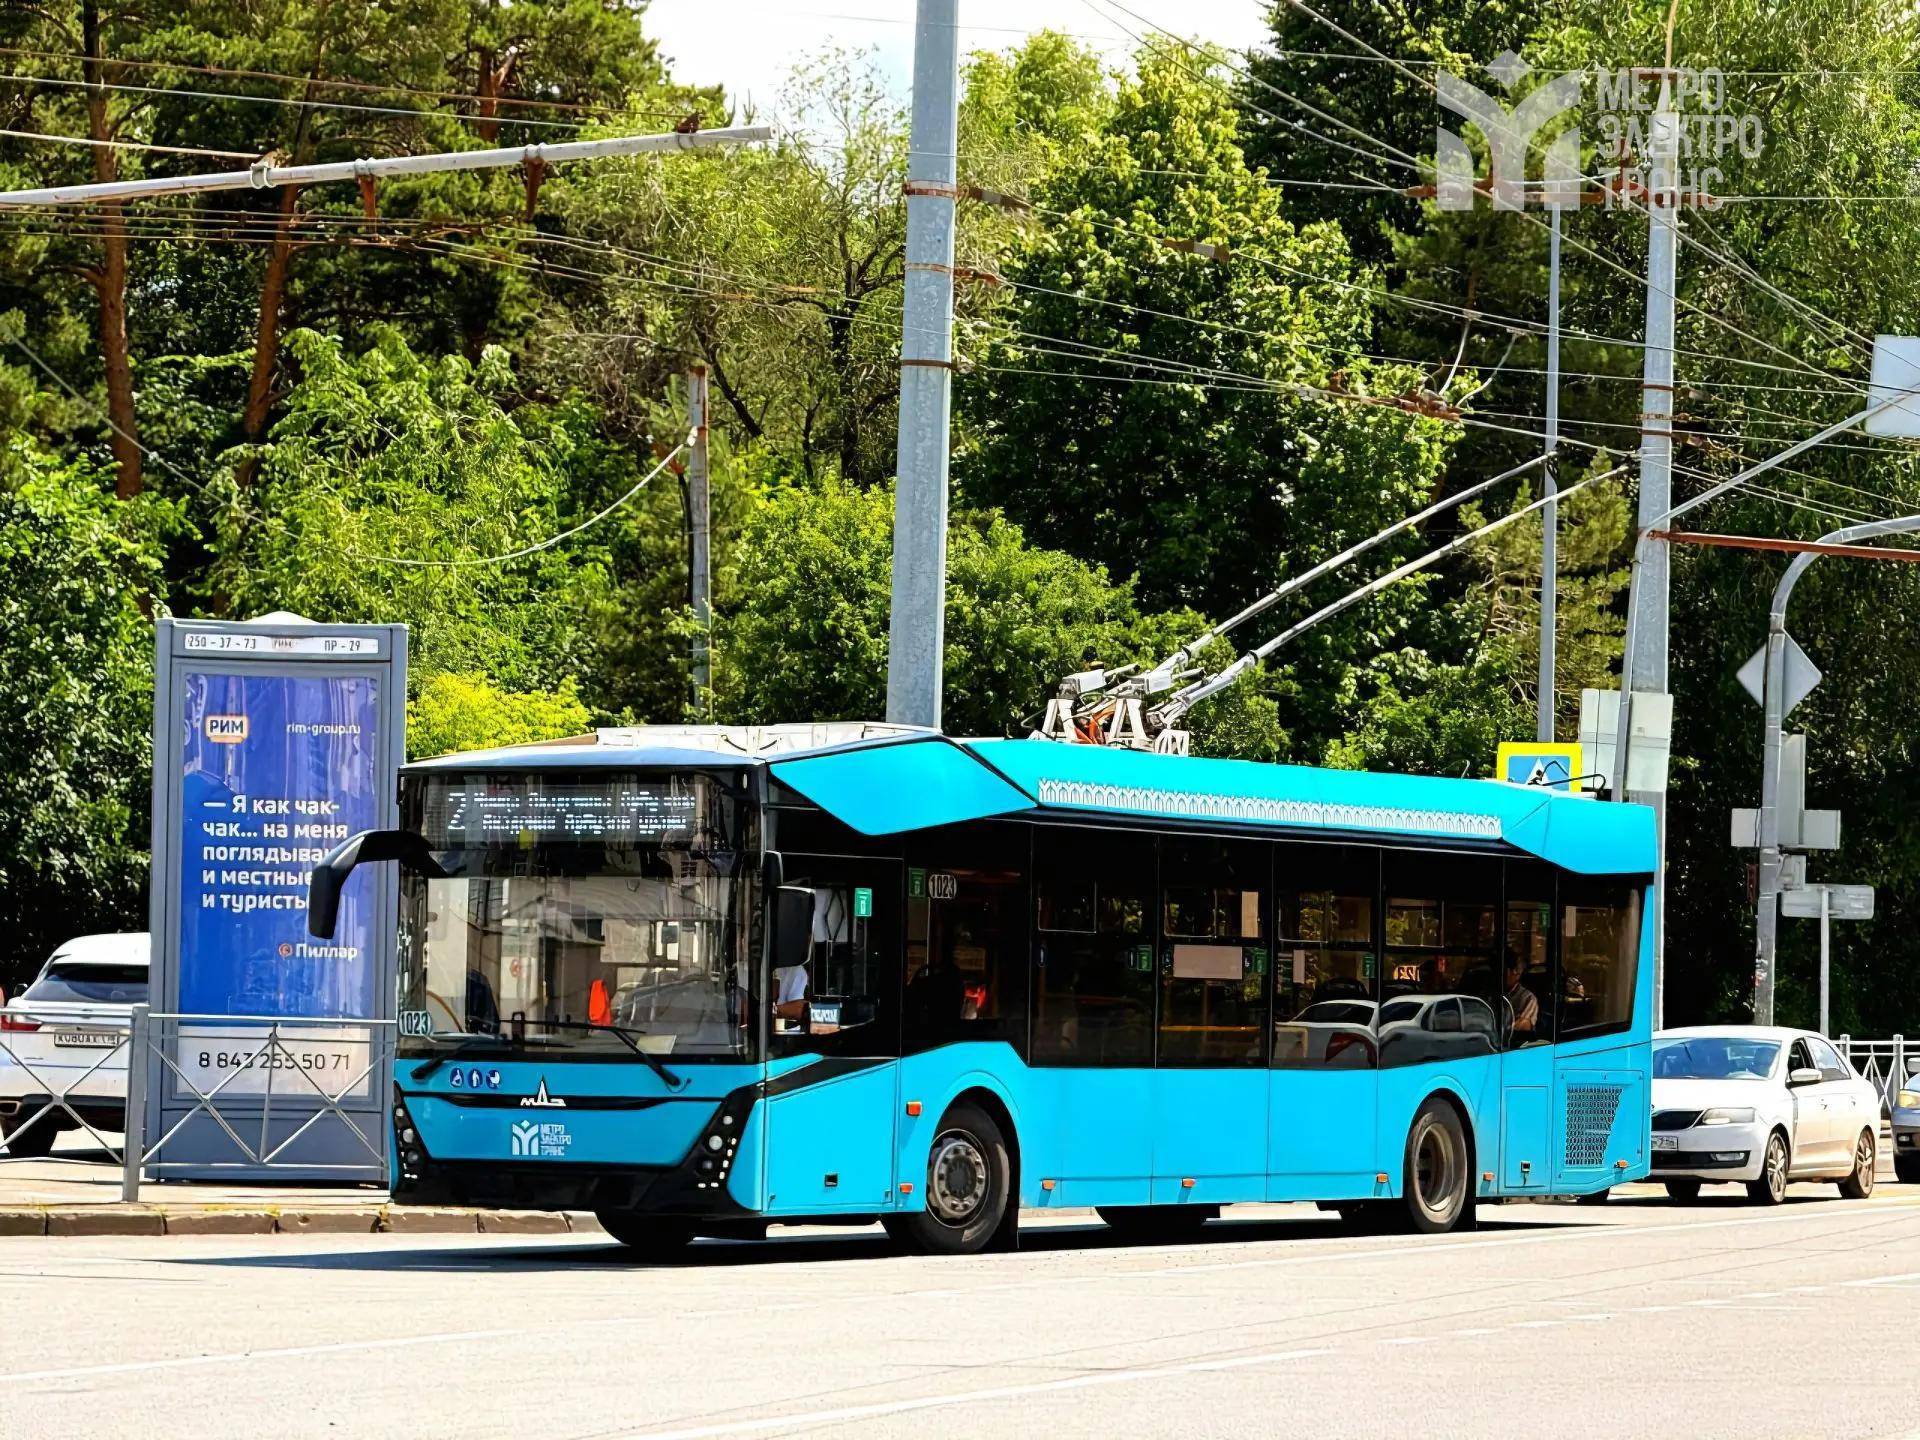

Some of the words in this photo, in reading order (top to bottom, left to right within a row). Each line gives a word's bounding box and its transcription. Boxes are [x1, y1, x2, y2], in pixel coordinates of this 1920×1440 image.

[209, 719, 243, 733] РИМ
[232, 795, 247, 813] Я
[253, 799, 290, 814] как
[263, 824, 288, 838] на
[294, 825, 348, 839] меня
[203, 869, 215, 884] и
[203, 893, 215, 908] и
[295, 943, 357, 960] Пиллар
[401, 1012, 429, 1035] 1023
[198, 1052, 210, 1068] 8
[217, 1052, 254, 1069] 843
[302, 1054, 326, 1069] 50
[331, 1054, 350, 1069] 71
